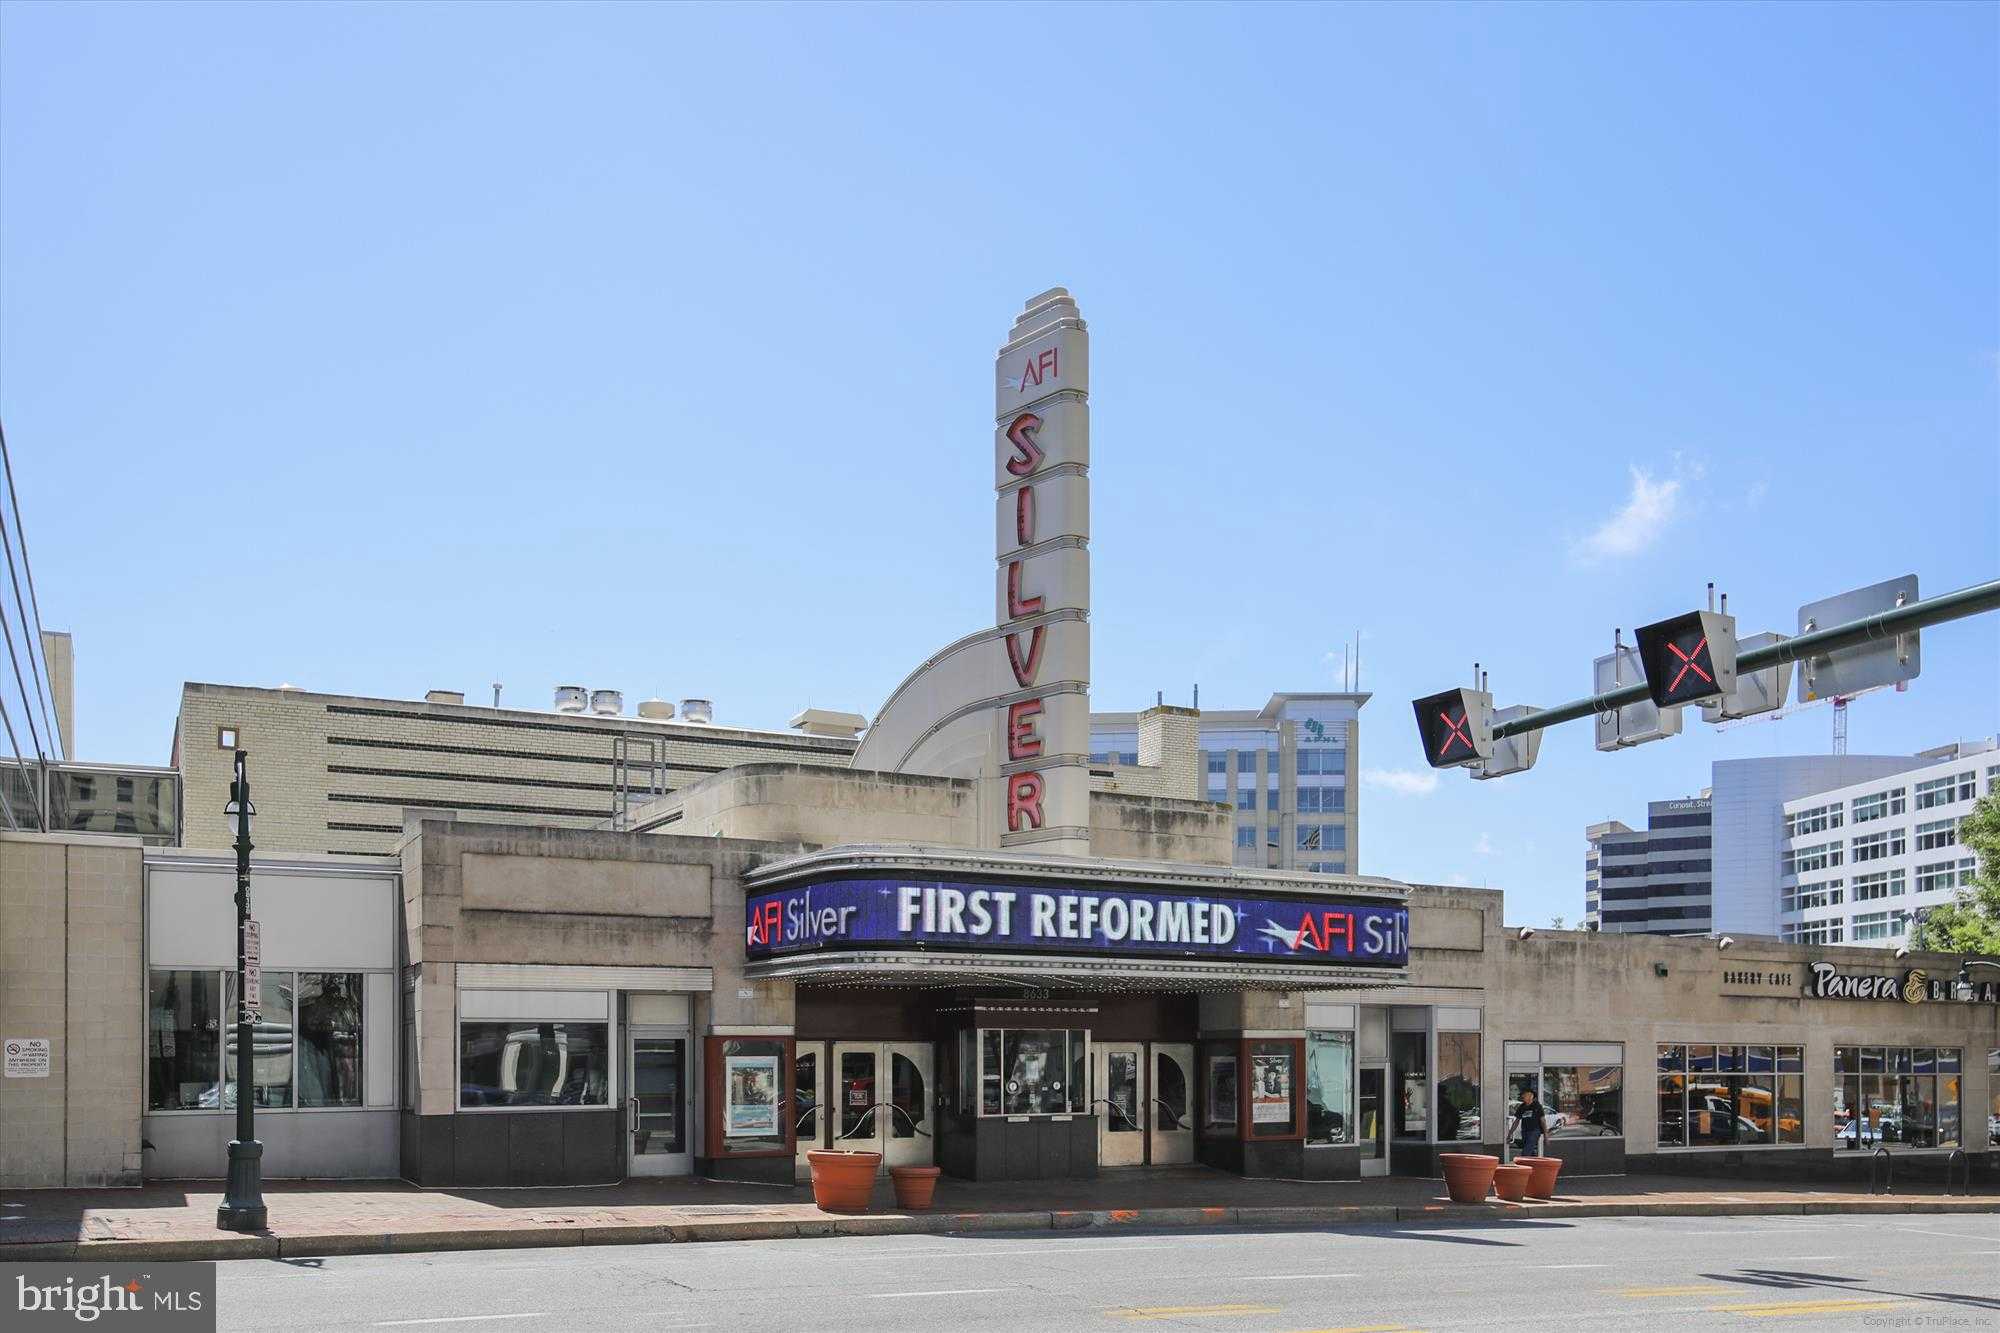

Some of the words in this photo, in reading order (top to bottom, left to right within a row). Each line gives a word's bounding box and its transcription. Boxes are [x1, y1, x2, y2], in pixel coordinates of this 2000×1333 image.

[1020, 347, 1058, 392] AFI
[1005, 412, 1046, 832] SILVER
[750, 901, 783, 944] AFI
[787, 887, 857, 940] Silver
[898, 887, 1017, 935] FIRST
[1030, 893, 1236, 944] REFORMED
[1293, 911, 1354, 952] AFI
[1724, 971, 1762, 984] BAKERY
[1769, 973, 1792, 985] CAFE
[1811, 962, 1898, 999] Panera
